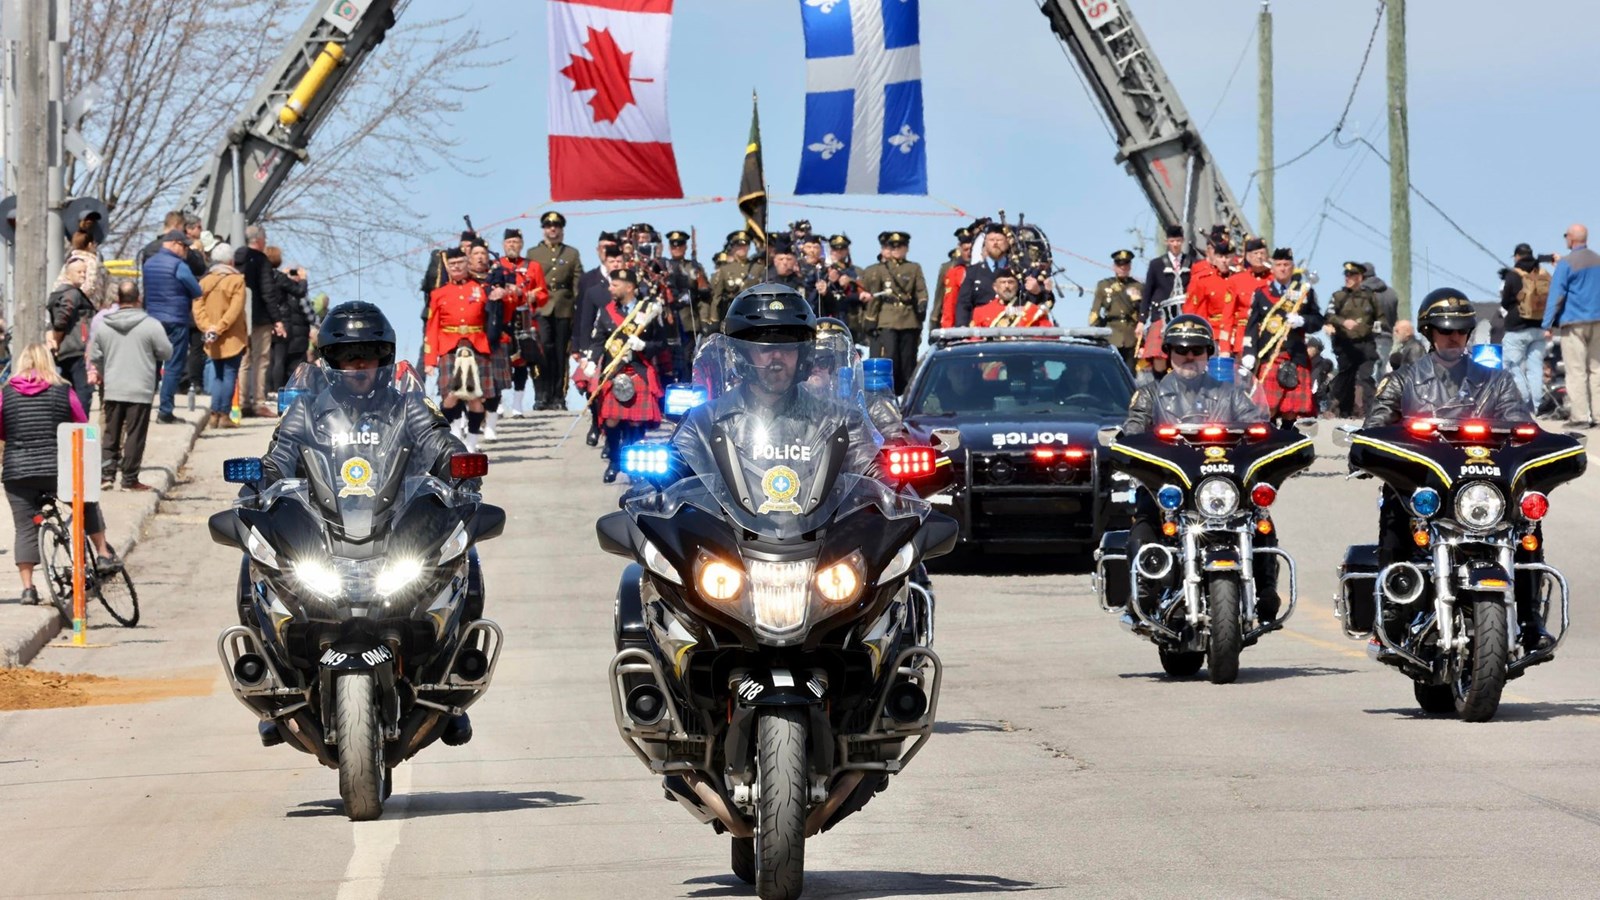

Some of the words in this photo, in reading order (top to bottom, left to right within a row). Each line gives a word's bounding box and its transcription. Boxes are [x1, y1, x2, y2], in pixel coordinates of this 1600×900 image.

[331, 431, 380, 446] POLICE
[752, 444, 811, 462] POLICE
[1200, 463, 1235, 474] POLICE
[1460, 465, 1501, 477] POLICE
